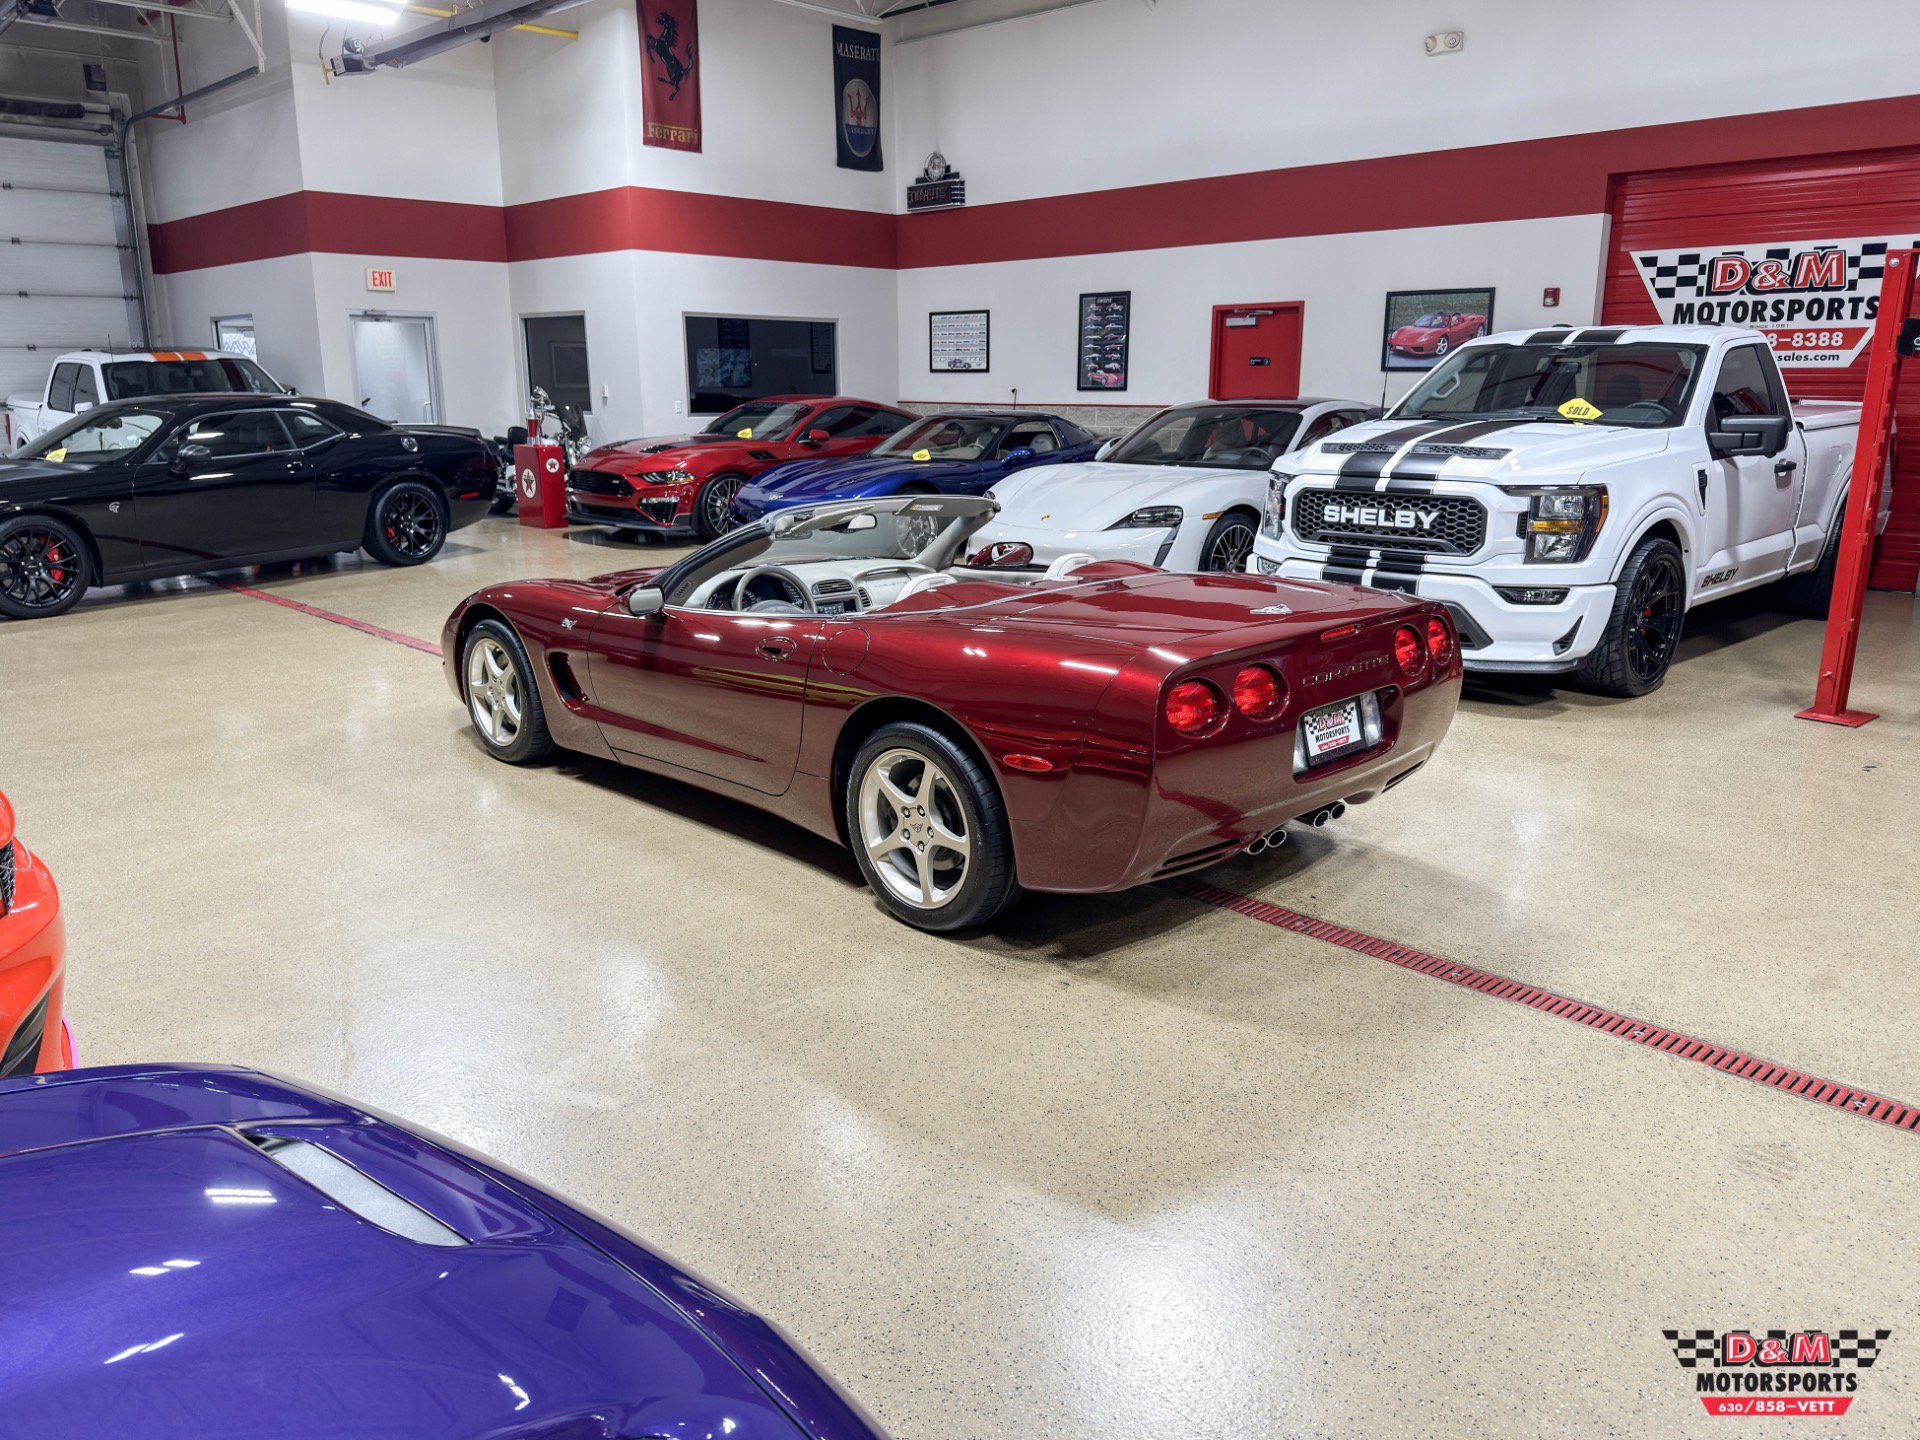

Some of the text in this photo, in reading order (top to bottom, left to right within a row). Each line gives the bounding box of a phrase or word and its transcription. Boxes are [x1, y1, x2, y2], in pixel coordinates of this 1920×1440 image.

[648, 122, 699, 144] Ferrari
[371, 270, 392, 287] EXIT
[1709, 250, 1848, 294] D&M
[1672, 295, 1880, 325] MOTORSPORTS
[1566, 406, 1590, 416] SOLD
[1324, 505, 1439, 530] SHELBY
[1701, 567, 1739, 588] SHELBY
[1302, 654, 1389, 687] CORVETTE
[1315, 725, 1350, 743] MOTORSPORTS
